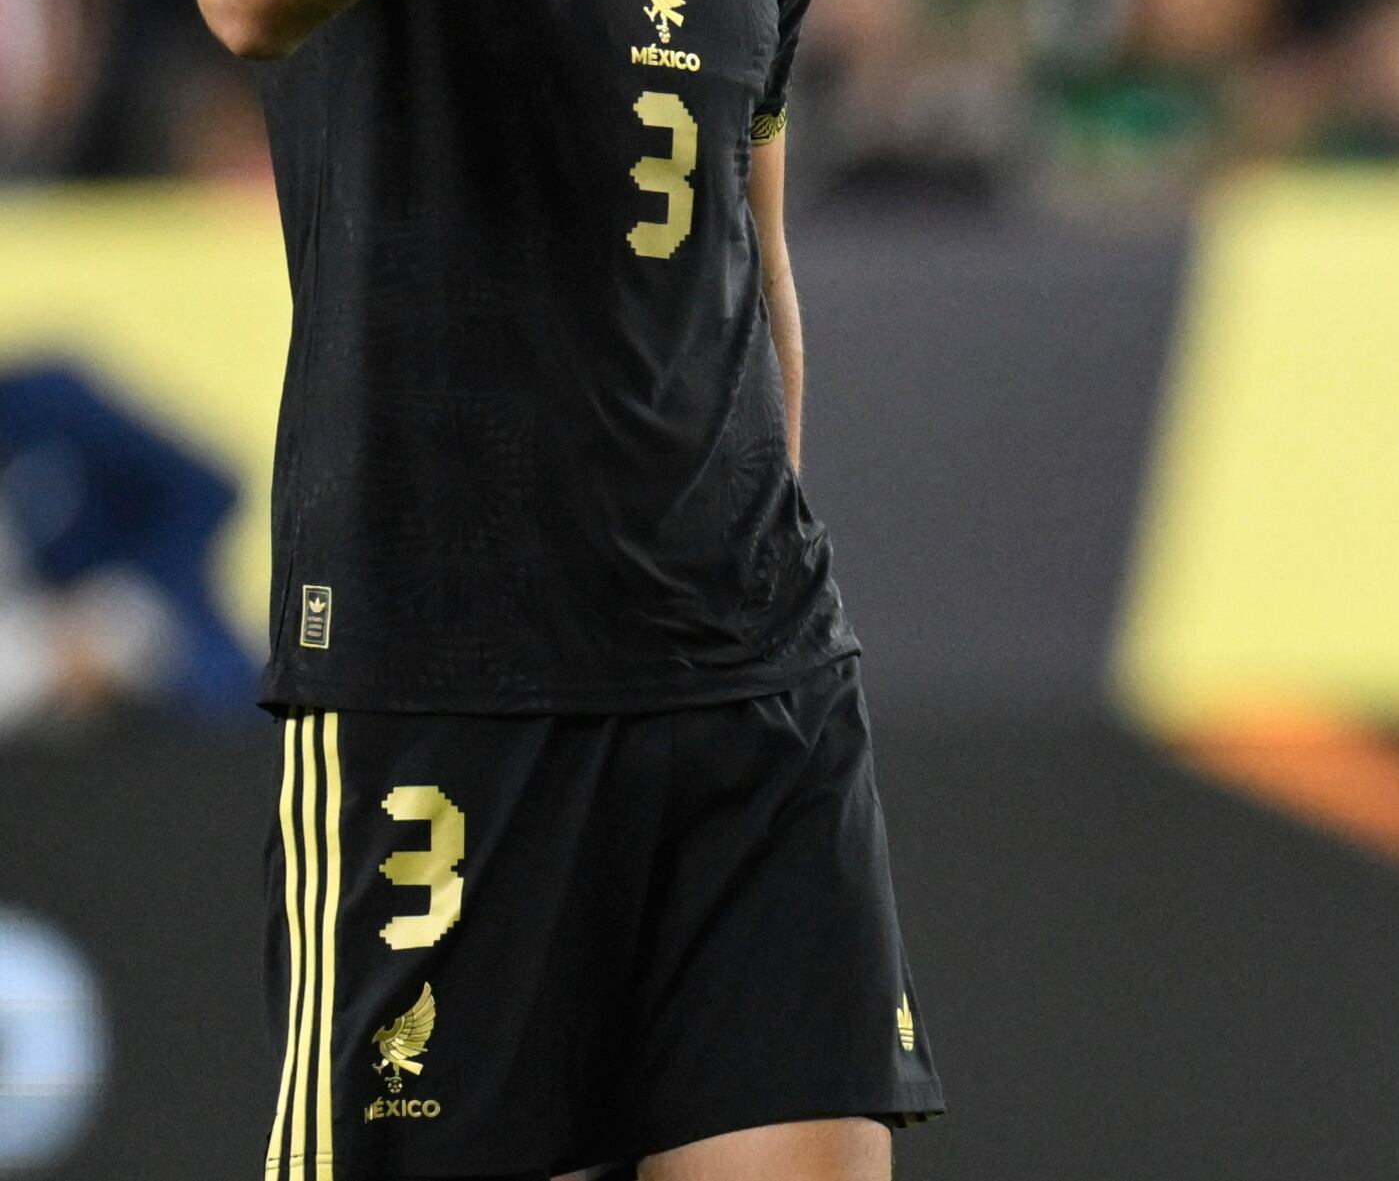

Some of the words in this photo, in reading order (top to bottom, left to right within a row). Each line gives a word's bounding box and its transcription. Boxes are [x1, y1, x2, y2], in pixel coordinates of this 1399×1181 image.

[631, 43, 701, 72] MÉXICO
[626, 91, 698, 260] 3
[378, 785, 465, 951] 3
